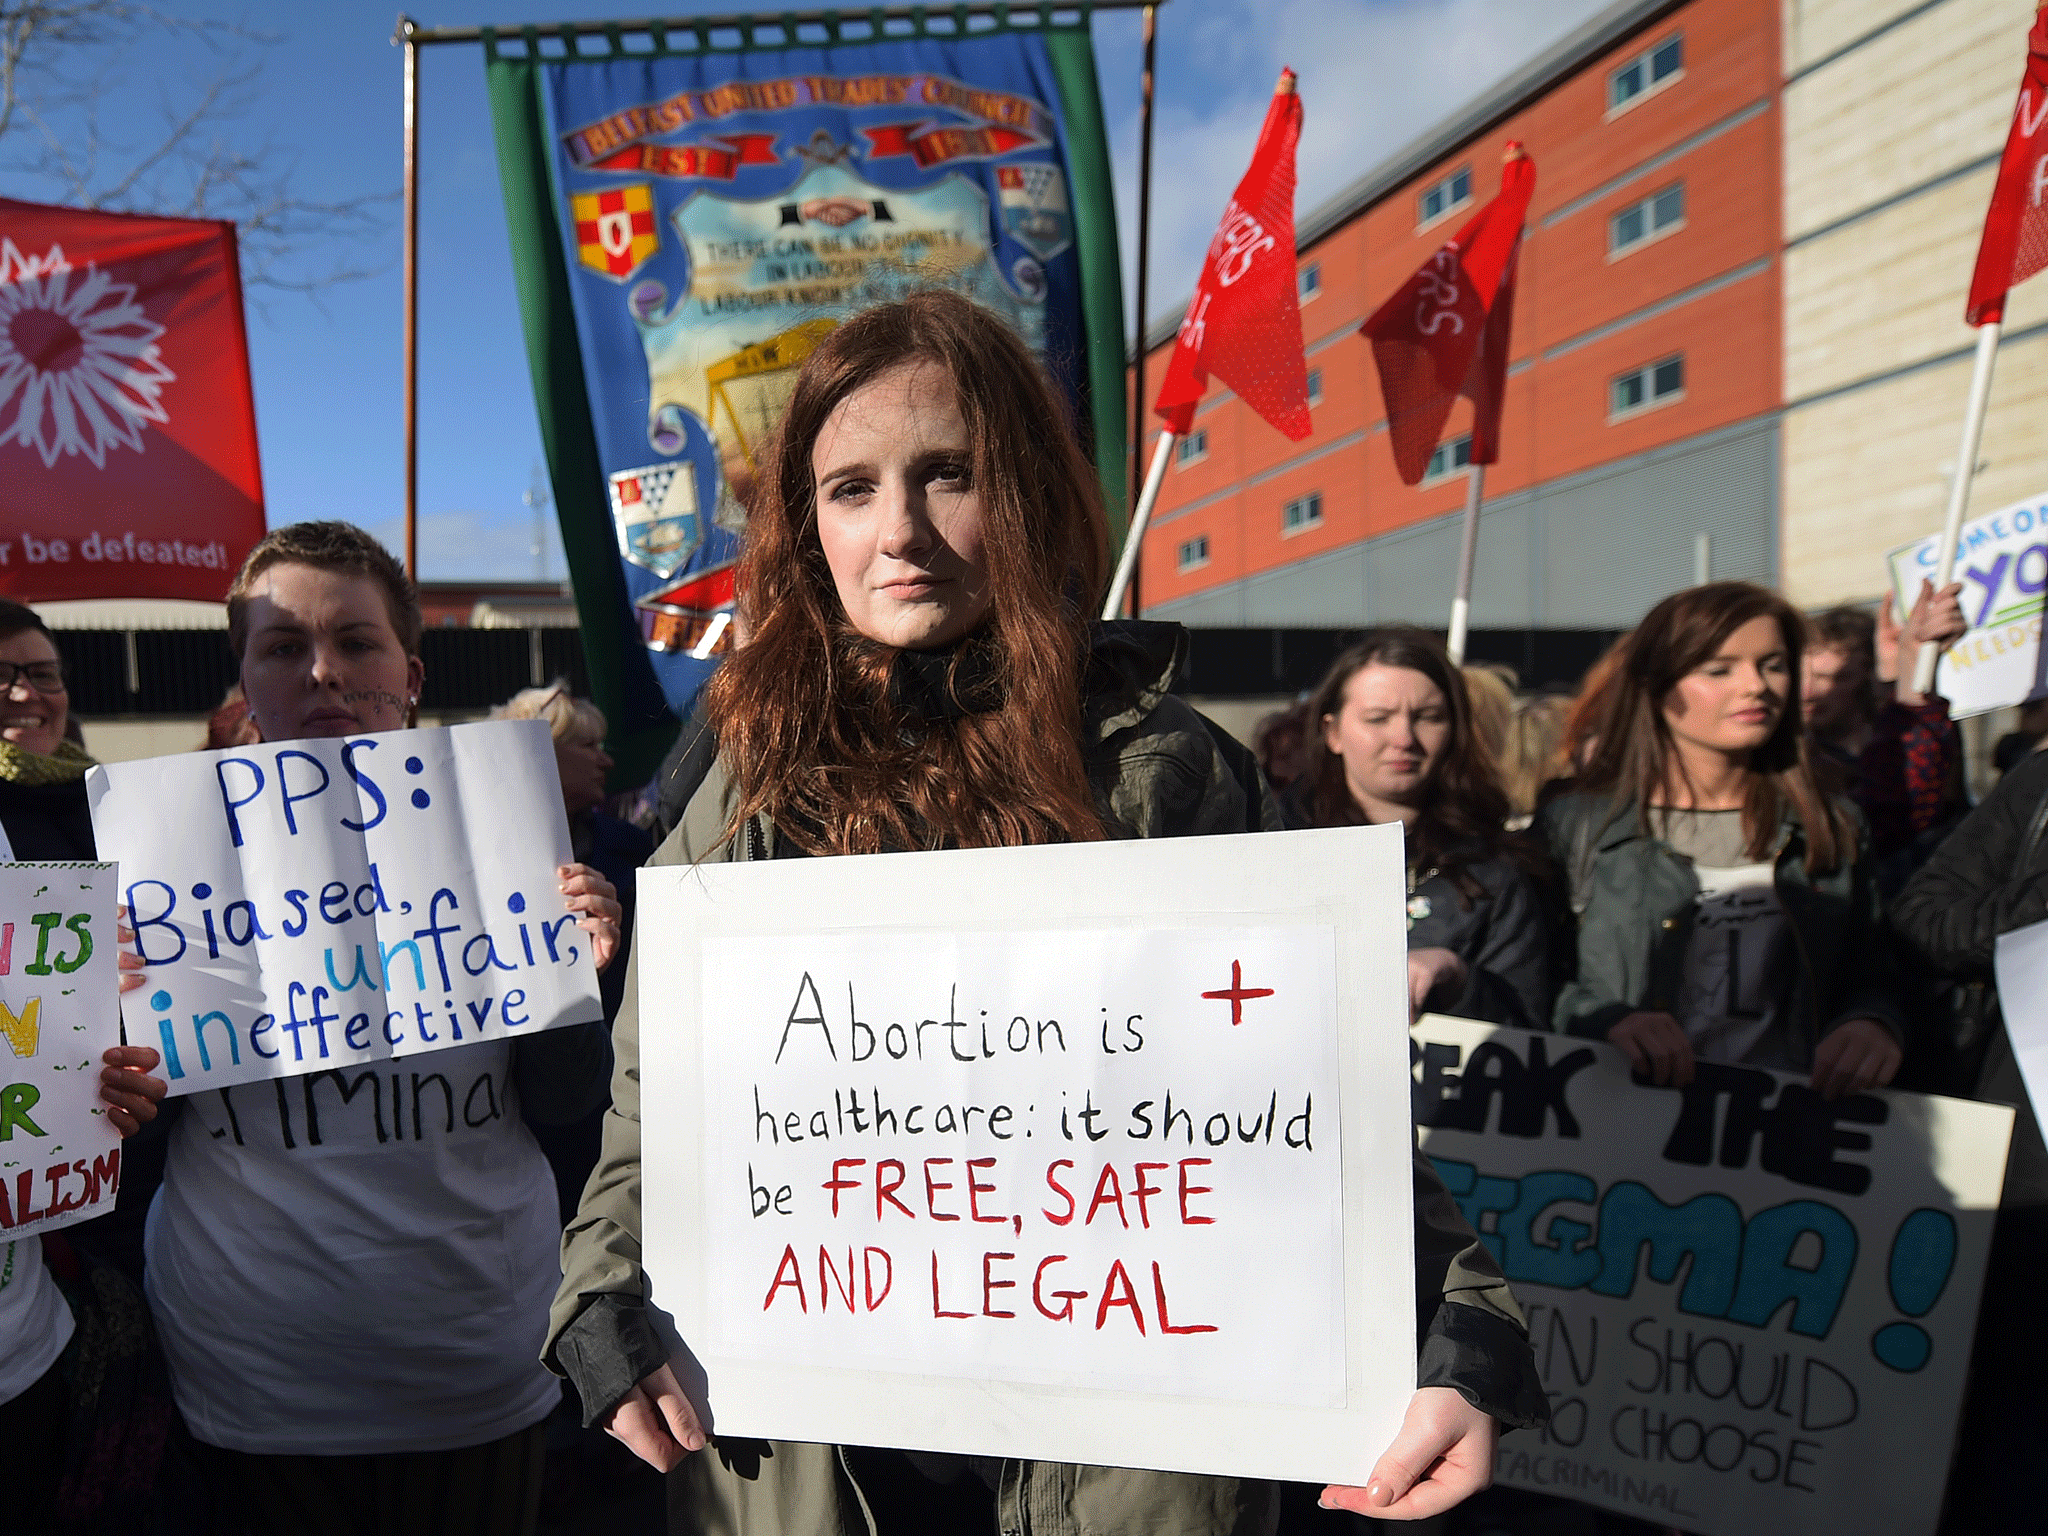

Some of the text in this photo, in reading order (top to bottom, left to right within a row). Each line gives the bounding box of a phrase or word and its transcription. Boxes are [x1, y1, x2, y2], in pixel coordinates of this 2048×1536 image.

[584, 92, 695, 156] BELFAST
[702, 78, 797, 117] UNITED
[708, 230, 963, 260] THERE CAN BE NO DIGNITY
[22, 532, 68, 562] be
[81, 530, 228, 570] defeated!
[215, 738, 431, 848] PPS:
[25, 912, 94, 976] IS
[126, 863, 412, 967] Biased,
[323, 887, 580, 993] unfair,
[150, 981, 530, 1081] ineffective
[775, 971, 1144, 1064] Abortion is
[753, 1084, 1313, 1152] healthcare: it should
[1411, 1035, 1890, 1197] EAK THE
[748, 1157, 1218, 1239] be FREE, SAFE
[763, 1244, 1219, 1337] AND LEGAL
[1625, 1315, 1860, 1432] SHOULD
[1609, 1403, 1825, 1494] CHOOSE
